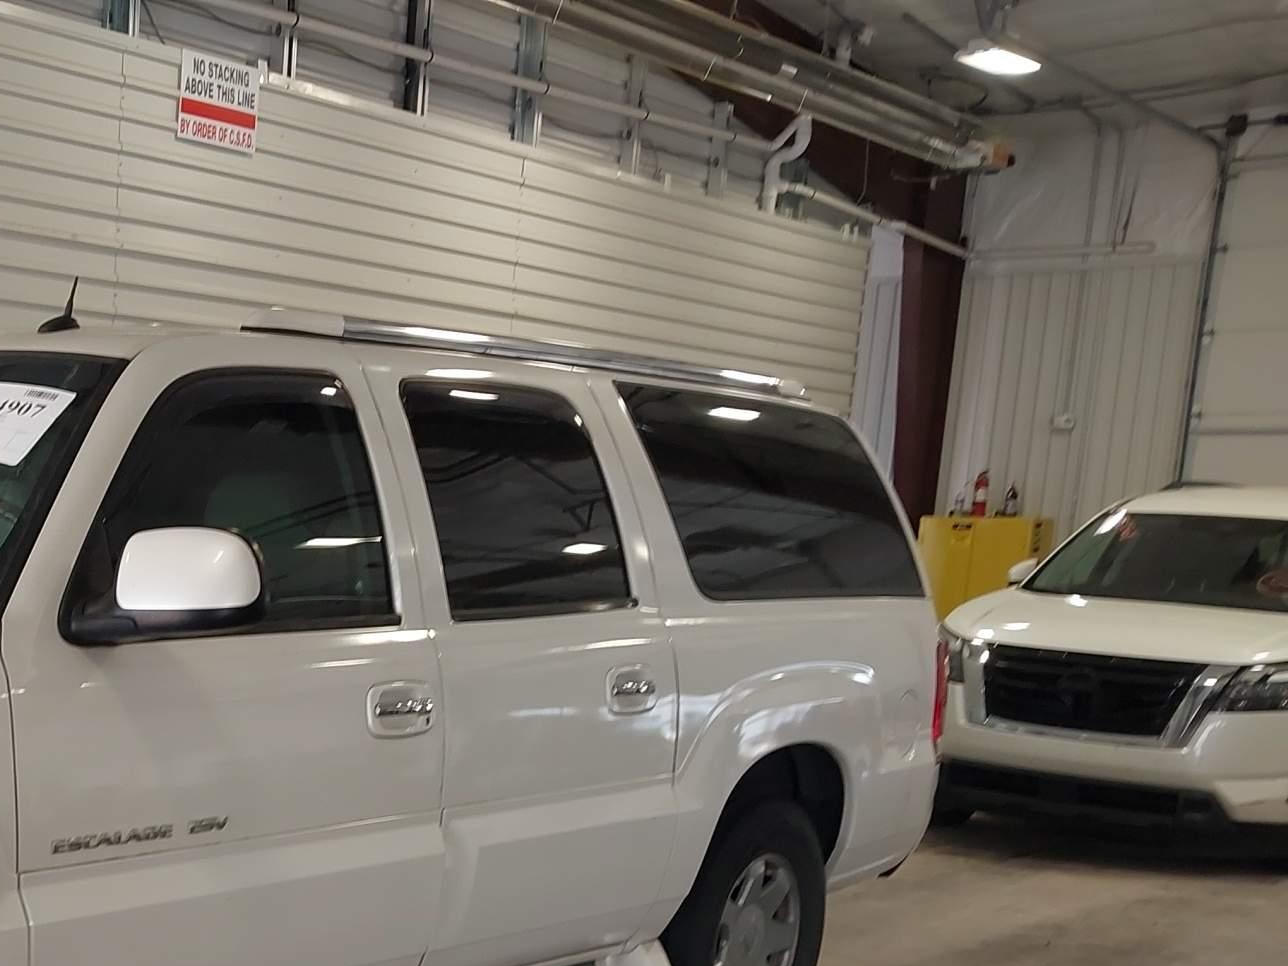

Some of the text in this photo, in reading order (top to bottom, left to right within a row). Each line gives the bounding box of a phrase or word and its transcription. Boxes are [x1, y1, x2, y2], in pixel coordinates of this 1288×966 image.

[193, 57, 250, 88] NO STACKING
[184, 77, 256, 110] ABOVE THIS LINE
[180, 118, 254, 149] BY ORDER OF C.S.F.D.
[51, 824, 174, 855] ESCALADE
